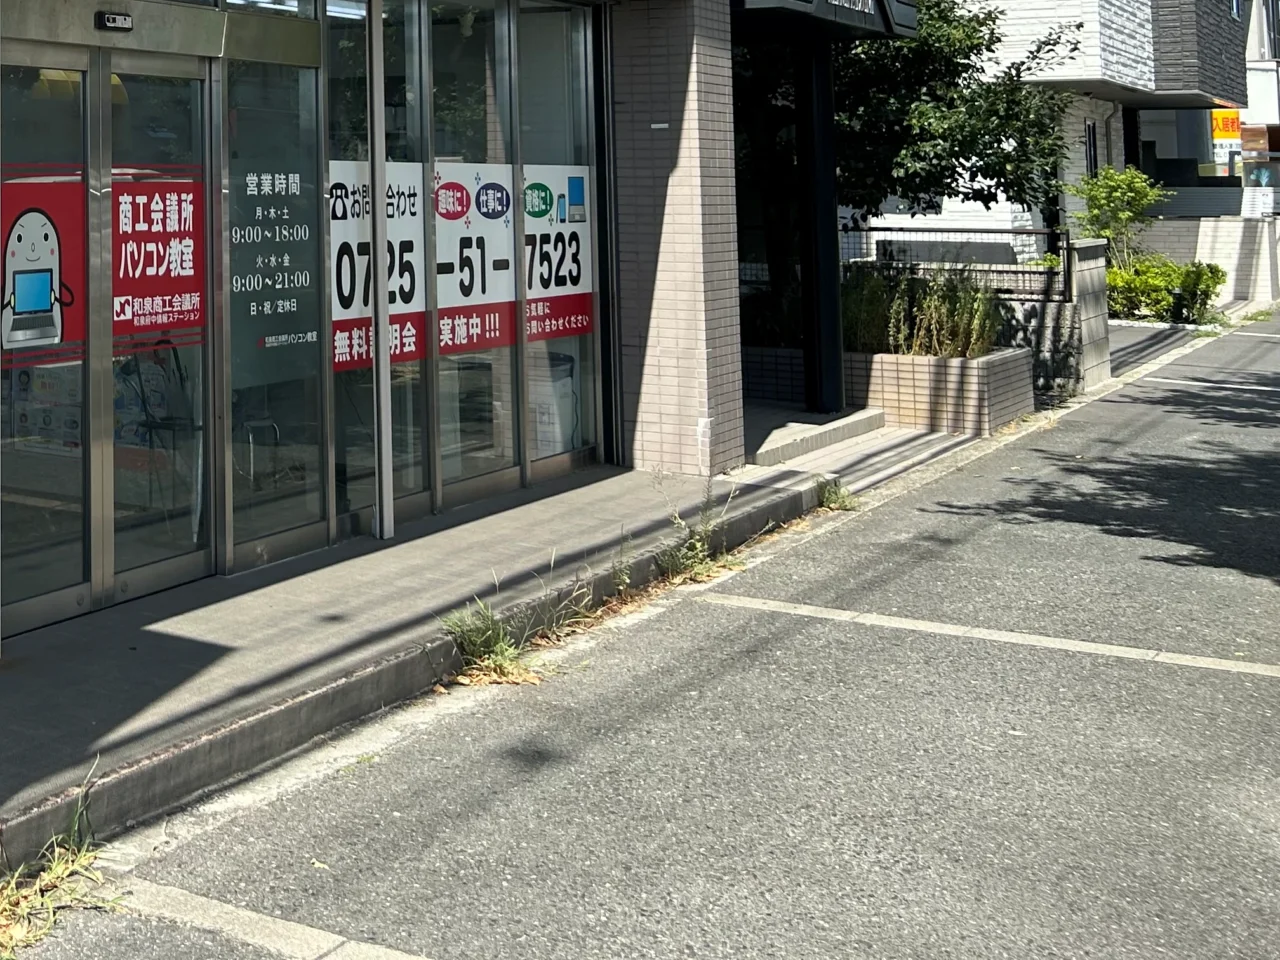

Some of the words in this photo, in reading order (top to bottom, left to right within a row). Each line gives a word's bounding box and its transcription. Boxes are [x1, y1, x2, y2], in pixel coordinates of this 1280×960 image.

[245, 173, 301, 196] 営業時間
[350, 183, 418, 220] お問合わせ
[118, 192, 194, 235] 商工会議所
[120, 236, 194, 279] パソコン教室
[524, 230, 582, 291] 7523
[132, 292, 200, 315] 和泉商工会議所
[333, 321, 417, 363] 無料明会
